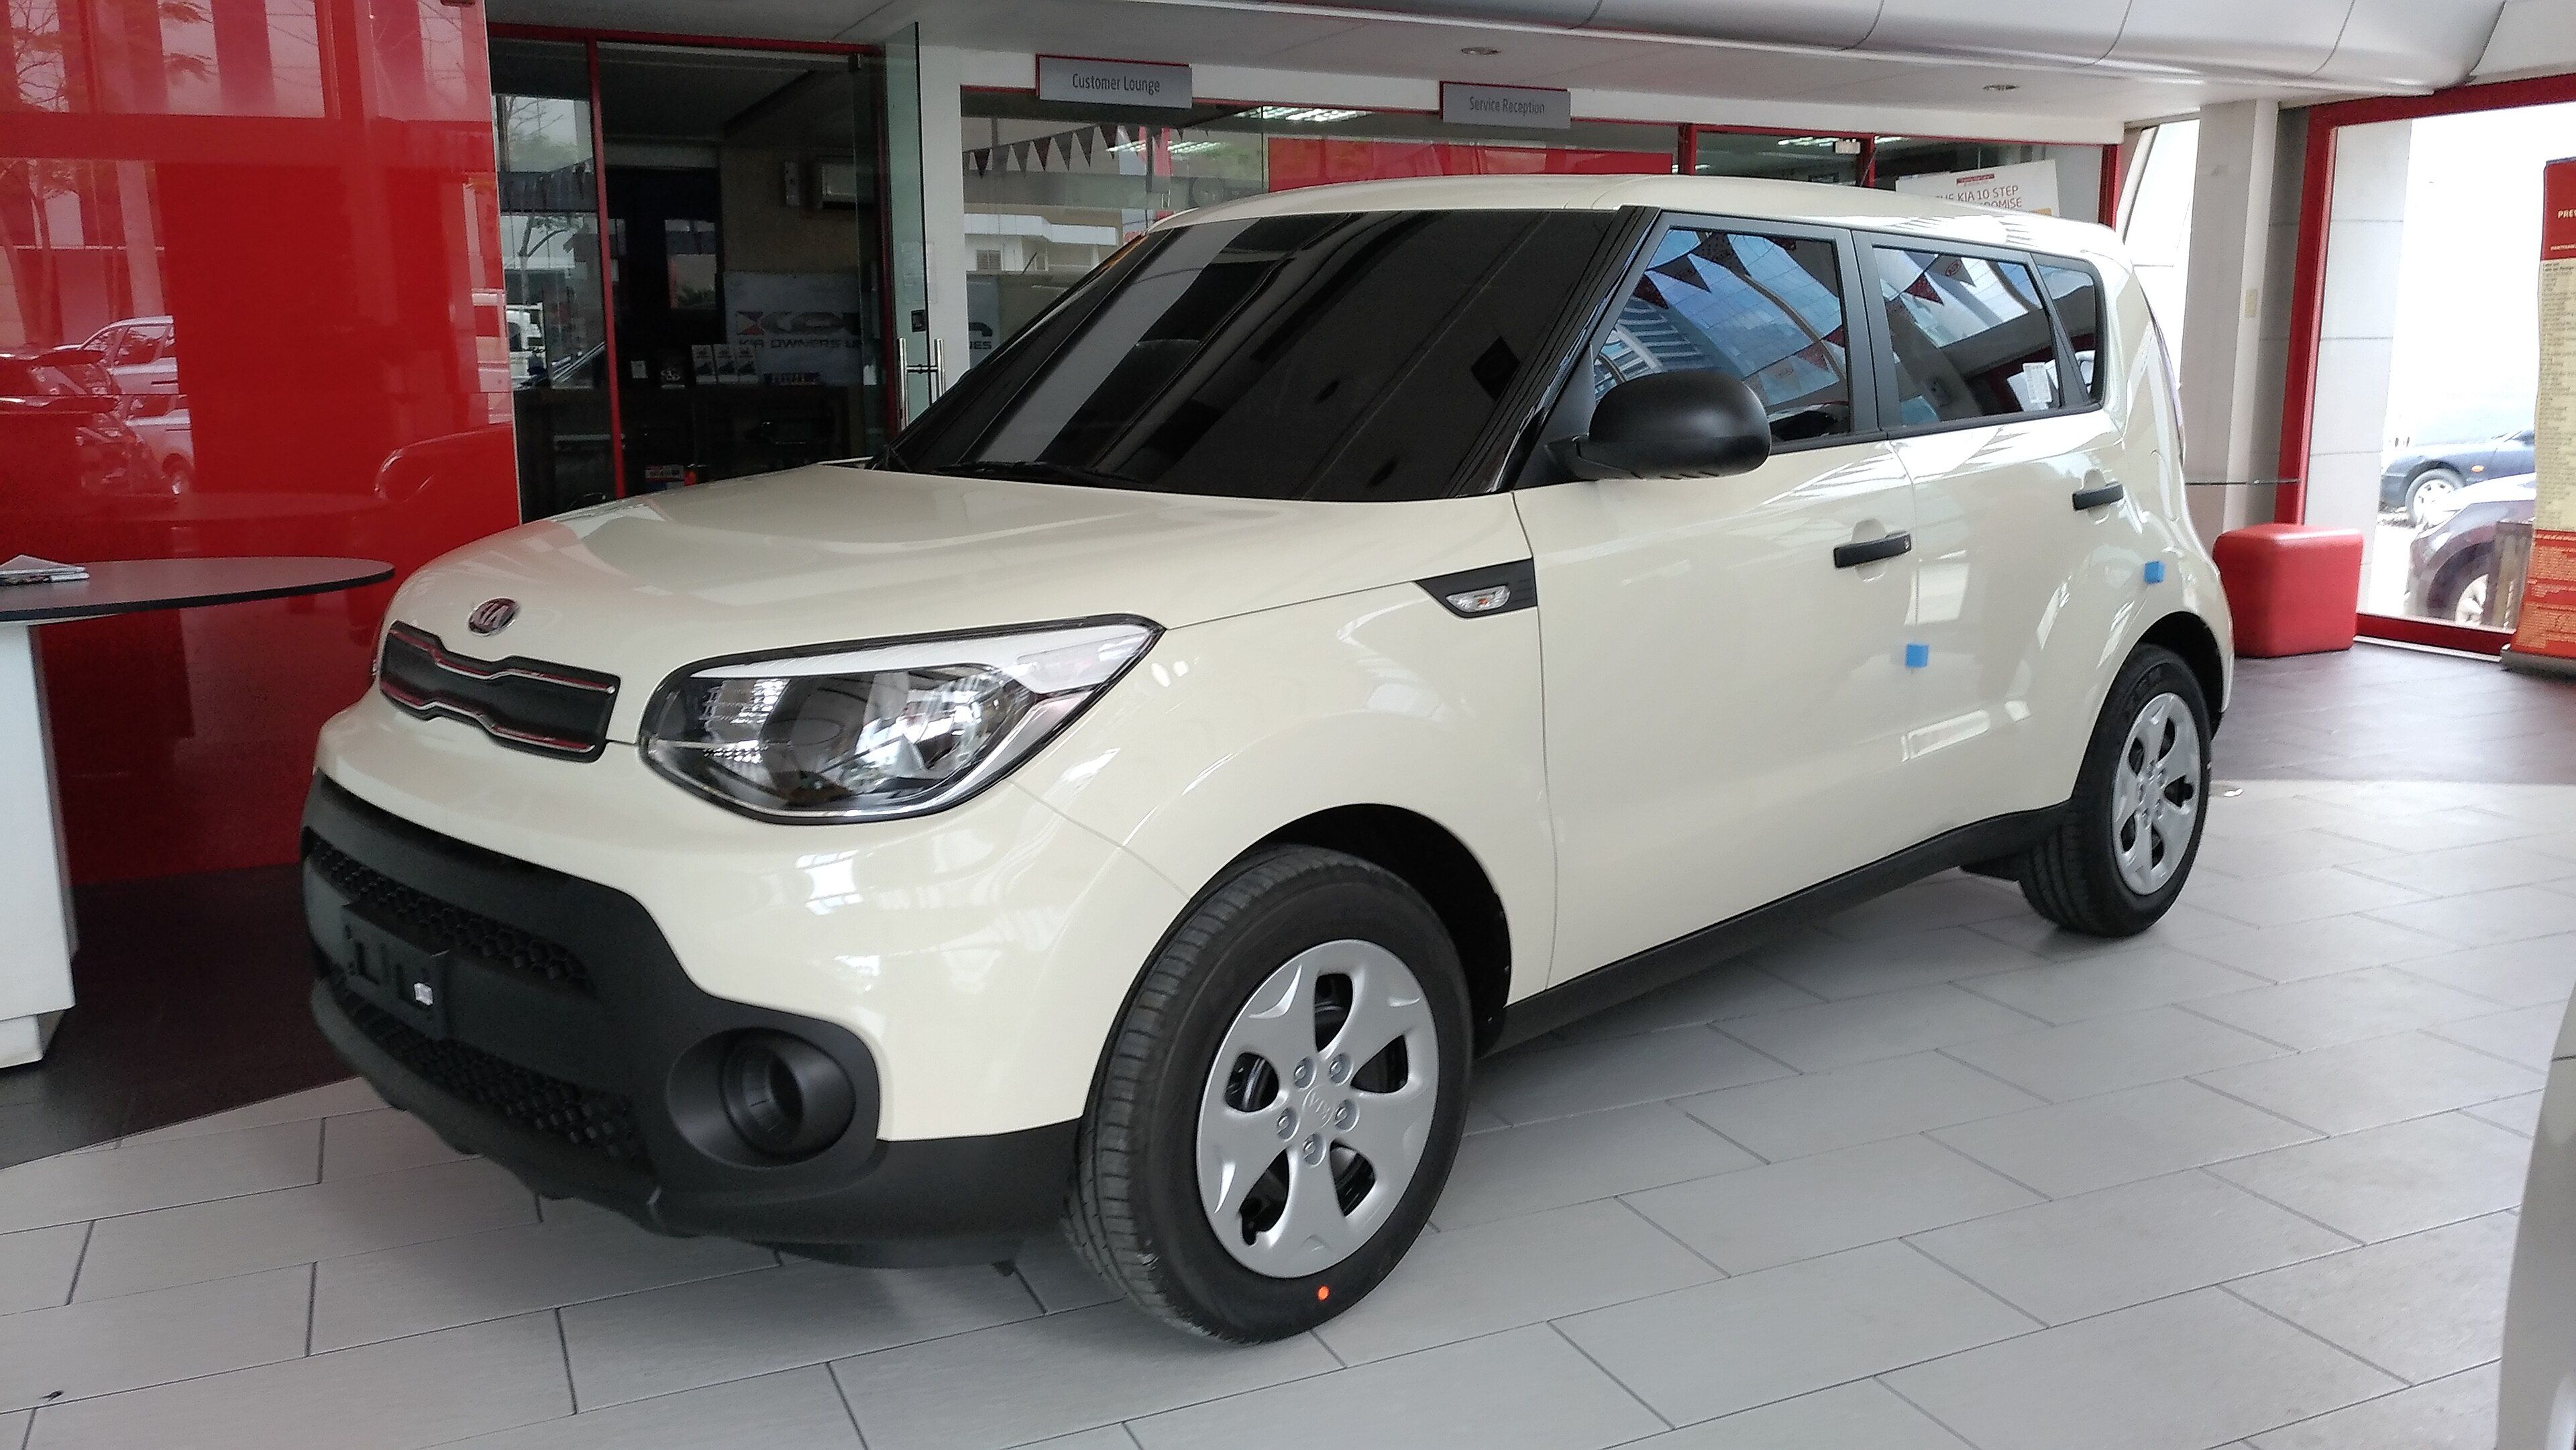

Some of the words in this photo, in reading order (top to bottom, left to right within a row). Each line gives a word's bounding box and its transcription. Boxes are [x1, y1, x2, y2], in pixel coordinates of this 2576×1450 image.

[1073, 73, 1120, 90] Customer
[1124, 76, 1160, 95] Lounge
[1470, 96, 1500, 112] Service
[1503, 99, 1545, 117] Reception
[1957, 191, 1974, 202] KIA
[1978, 189, 1990, 200] 10
[1992, 185, 2019, 199] STEP
